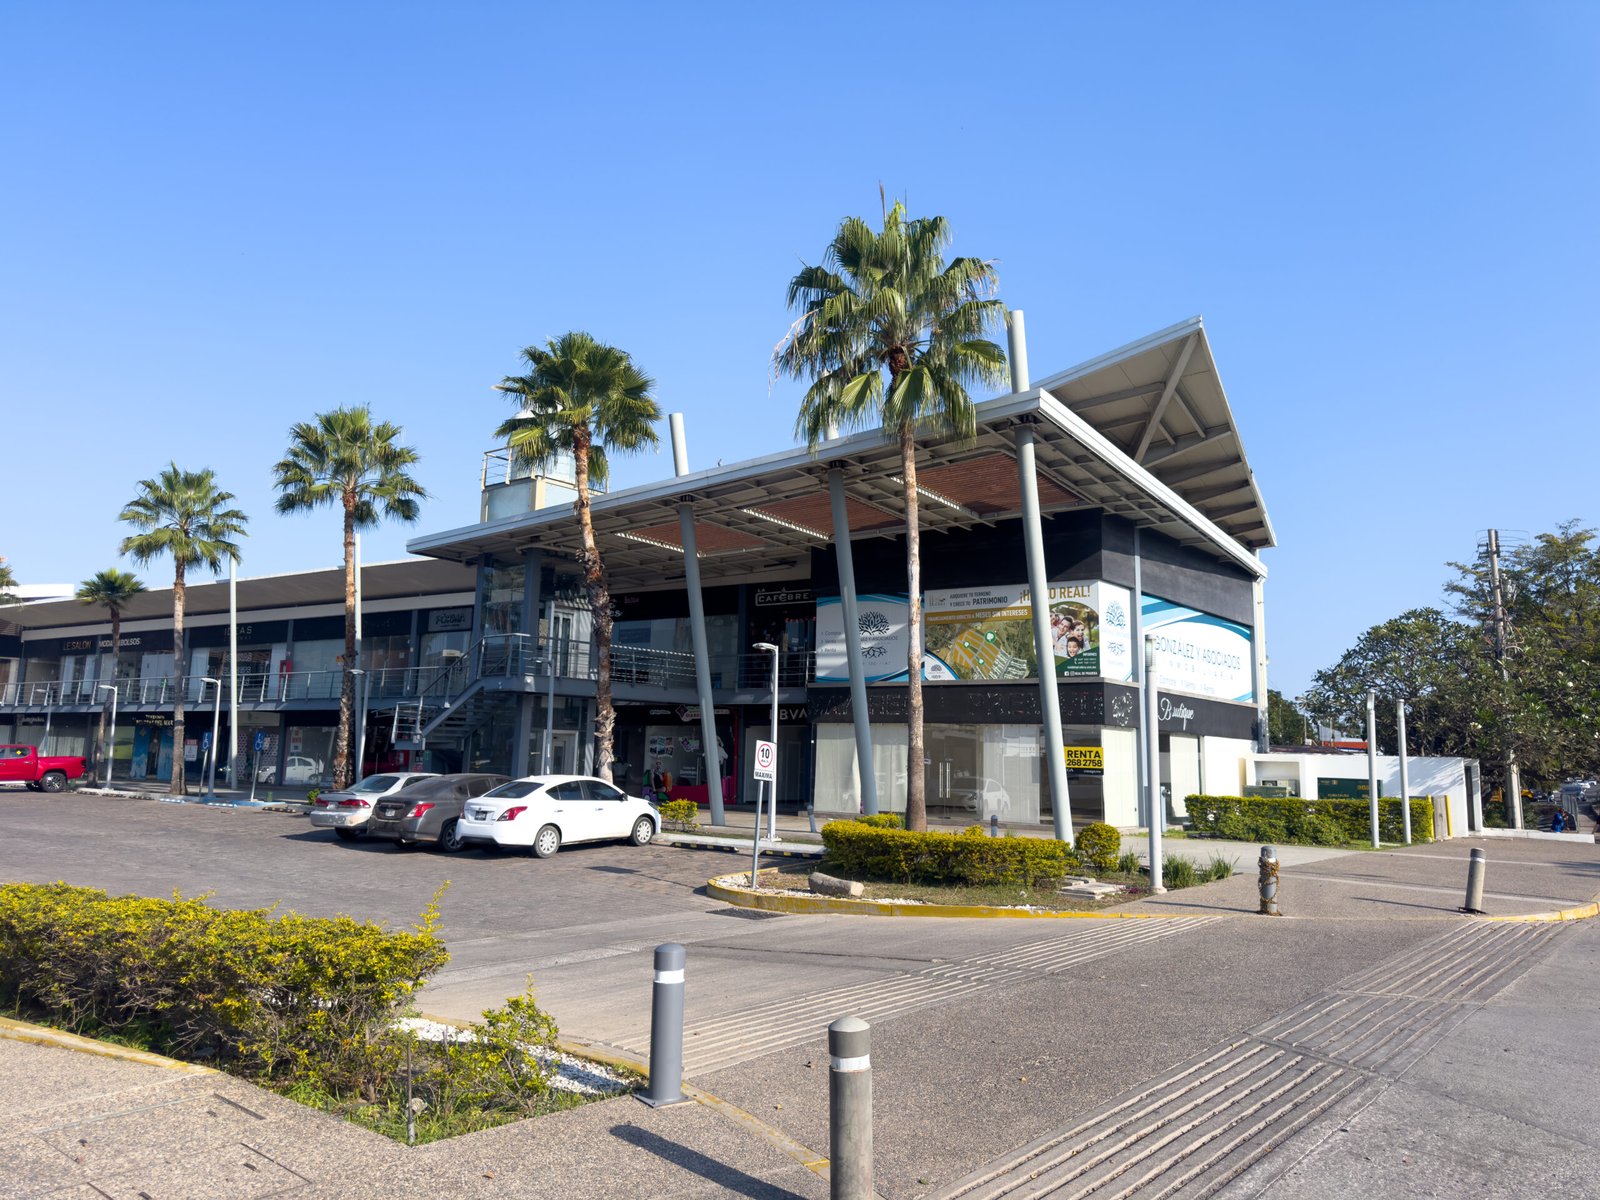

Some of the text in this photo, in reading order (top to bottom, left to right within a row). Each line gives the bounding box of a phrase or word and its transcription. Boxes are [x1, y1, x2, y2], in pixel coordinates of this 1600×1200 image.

[1059, 584, 1091, 599] REAL!
[972, 595, 1008, 606] PATRIMONIO
[1001, 609, 1028, 617] INTERESES
[1202, 648, 1241, 670] ASOCIADOS
[769, 708, 808, 721] BVA
[761, 747, 770, 759] 10
[1067, 750, 1101, 759] RENTA
[1067, 759, 1103, 767] 268 2758
